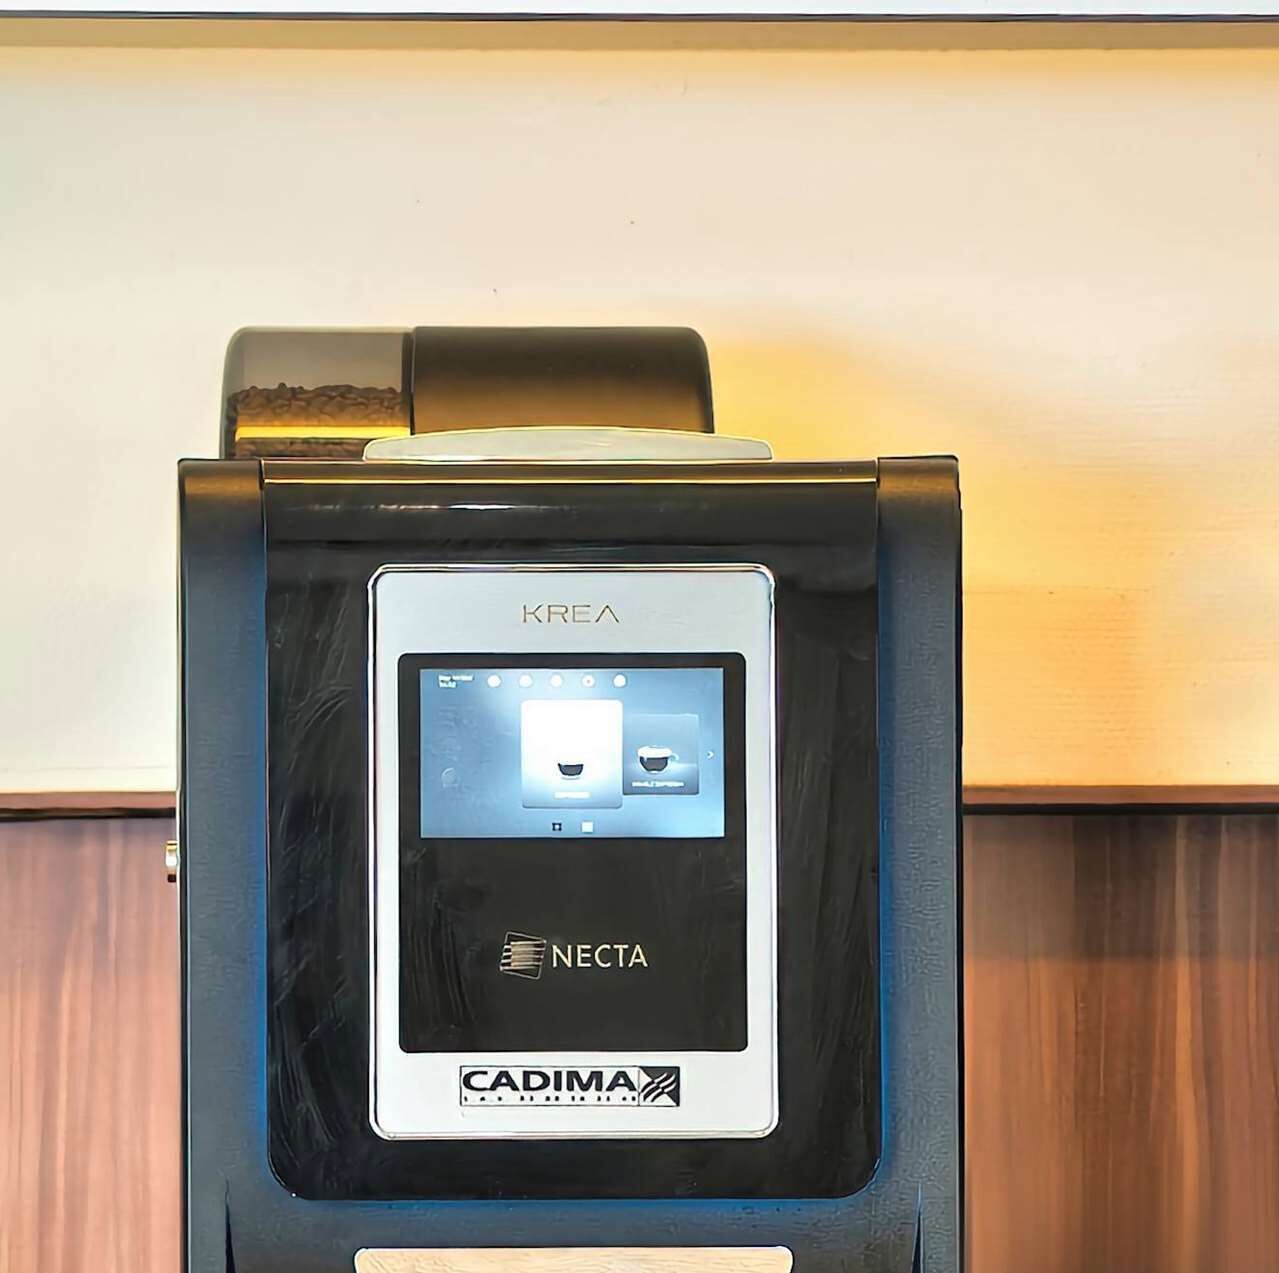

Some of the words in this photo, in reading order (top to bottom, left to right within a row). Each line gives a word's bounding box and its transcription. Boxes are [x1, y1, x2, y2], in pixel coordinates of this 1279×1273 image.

[522, 604, 620, 624] KREA
[551, 944, 649, 969] NECTA
[462, 1070, 638, 1092] CADIMA
